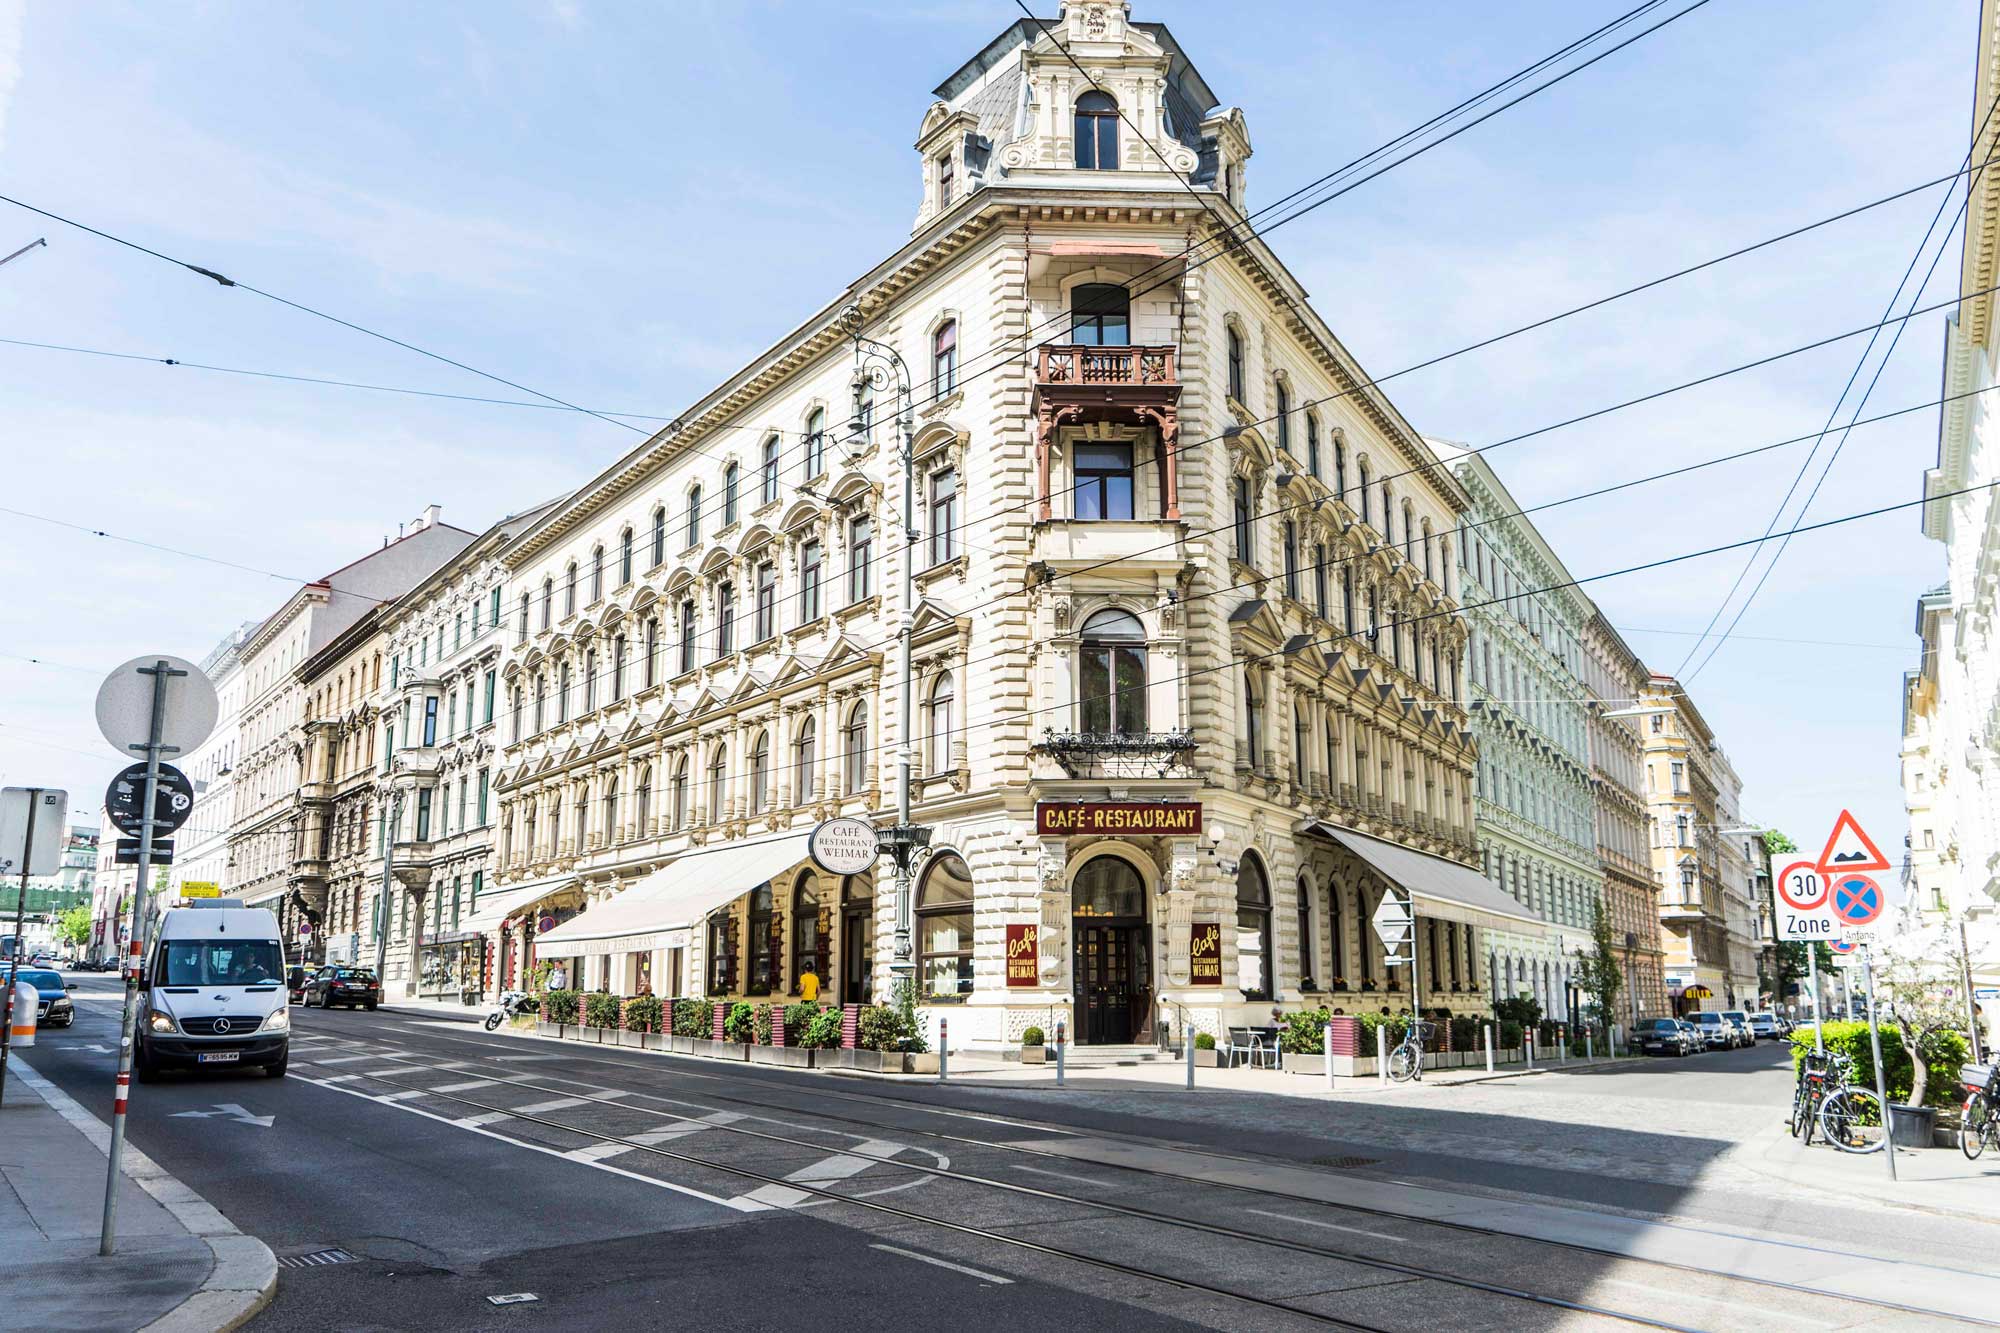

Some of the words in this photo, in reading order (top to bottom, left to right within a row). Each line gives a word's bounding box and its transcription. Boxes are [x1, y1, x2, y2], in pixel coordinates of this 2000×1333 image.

[1045, 807, 1196, 828] CAFÉ-RESTAURANT
[832, 825, 861, 837] CAFÉ
[819, 837, 874, 848] RESTAURANT
[823, 847, 869, 859] WEIMAR
[1792, 874, 1817, 897] 30
[1786, 914, 1831, 934] Zone
[1845, 931, 1875, 942] Anfang
[1008, 965, 1036, 978] WEIMAR
[1192, 964, 1220, 977] WEIMAR
